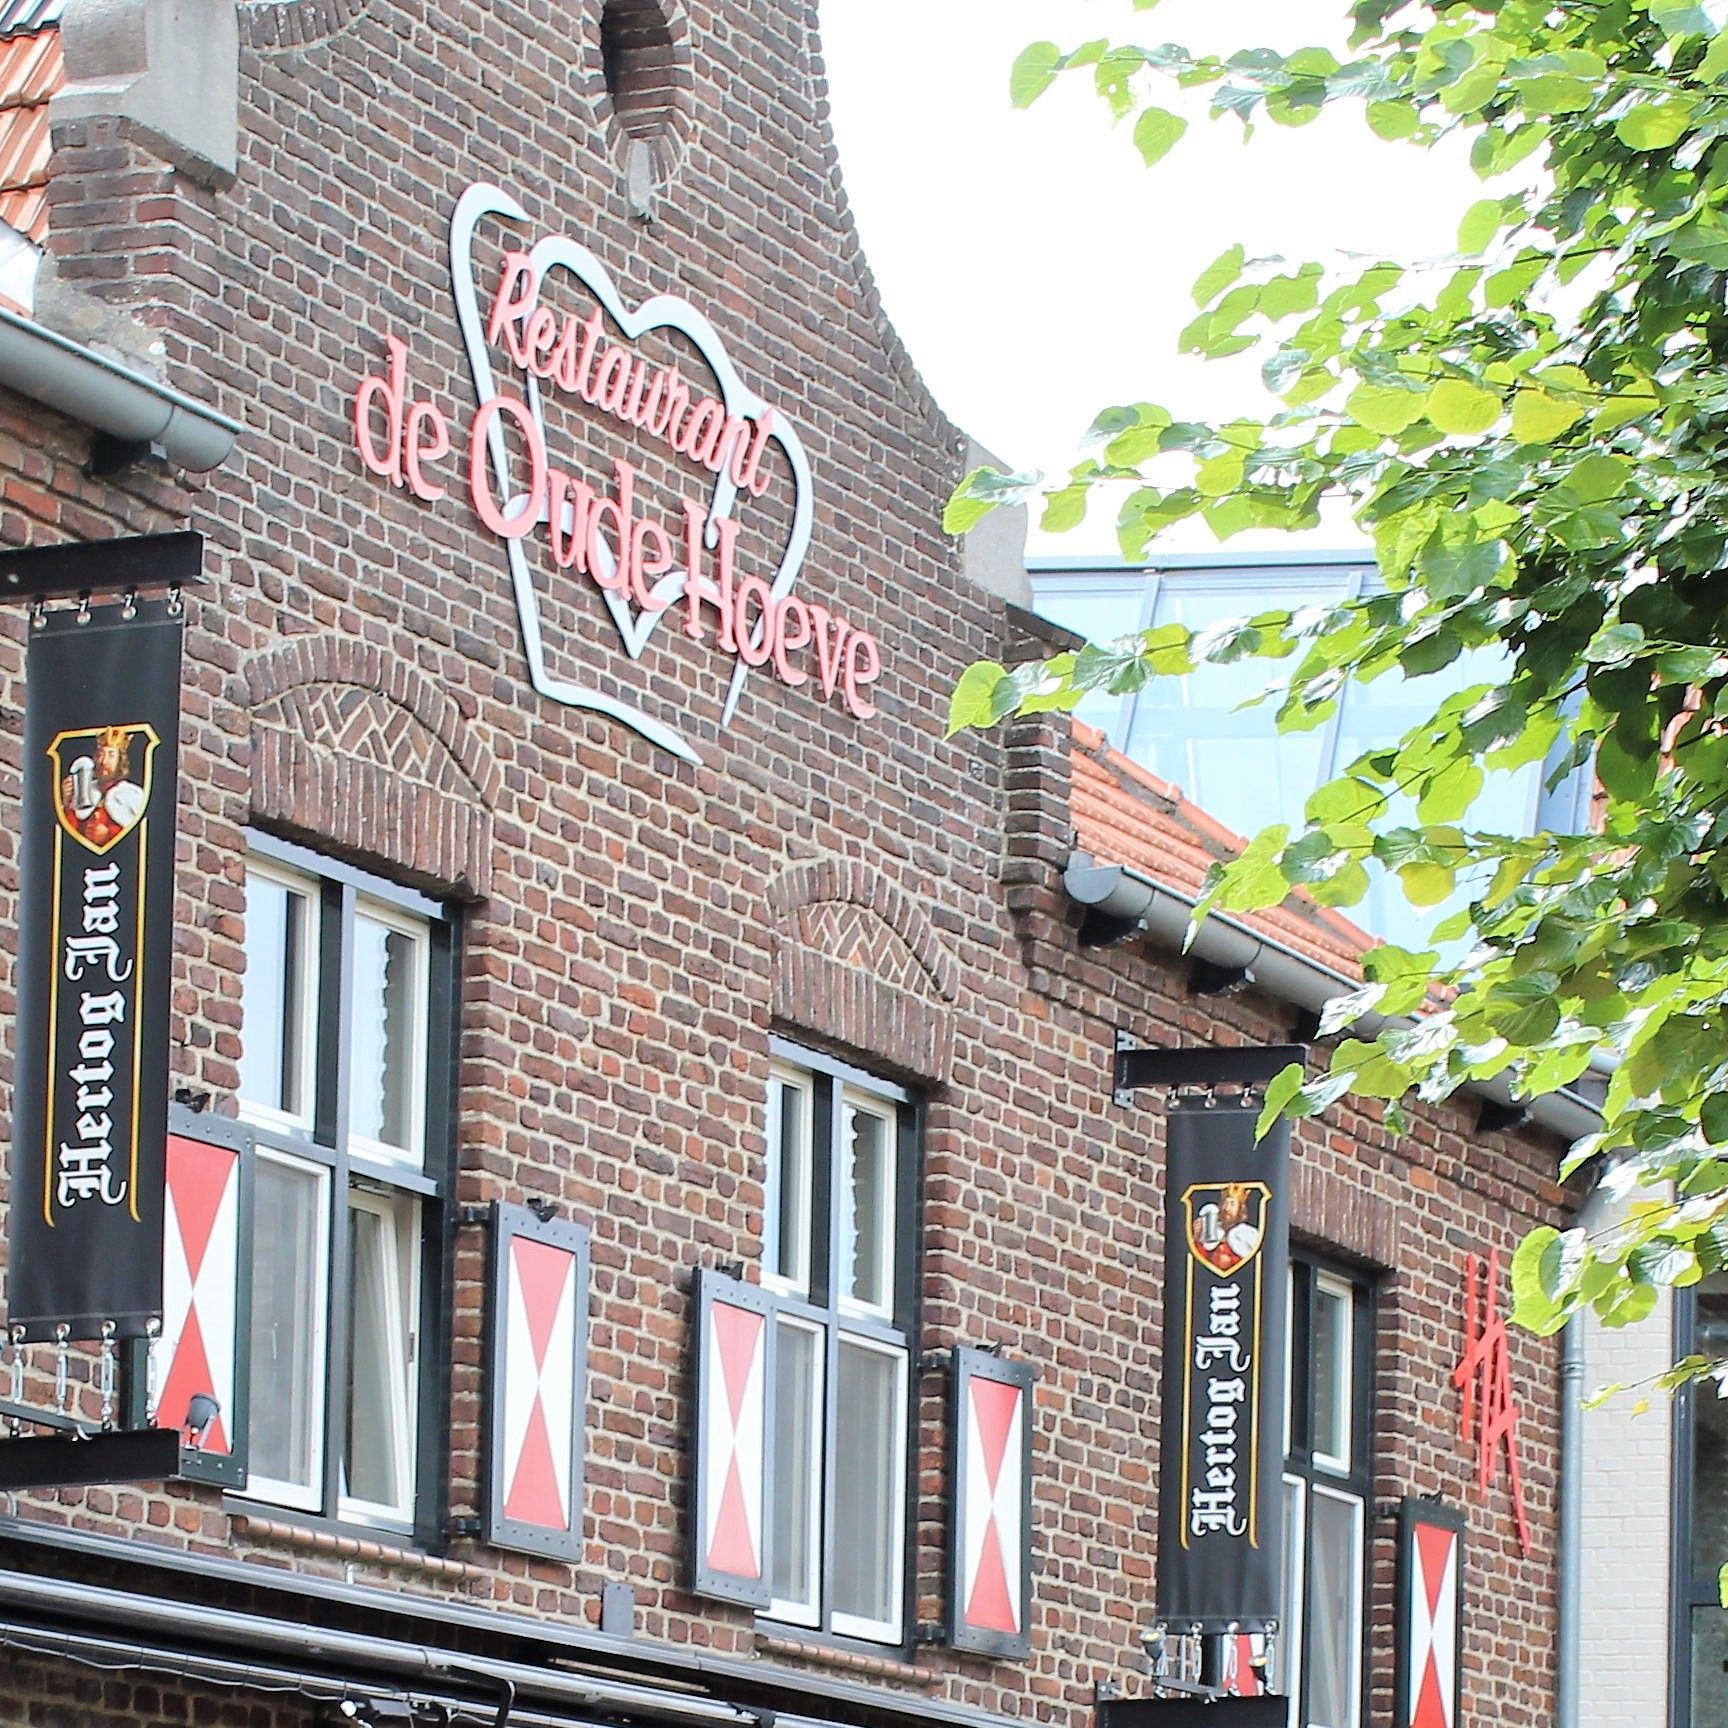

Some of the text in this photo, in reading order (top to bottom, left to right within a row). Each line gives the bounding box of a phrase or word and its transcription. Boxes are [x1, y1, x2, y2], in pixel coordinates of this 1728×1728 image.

[488, 250, 773, 498] Restaurant
[355, 334, 881, 720] de Oude Hoeve
[56, 861, 135, 1208] Hertog Jan
[1190, 1281, 1252, 1537] Hertog Jan
